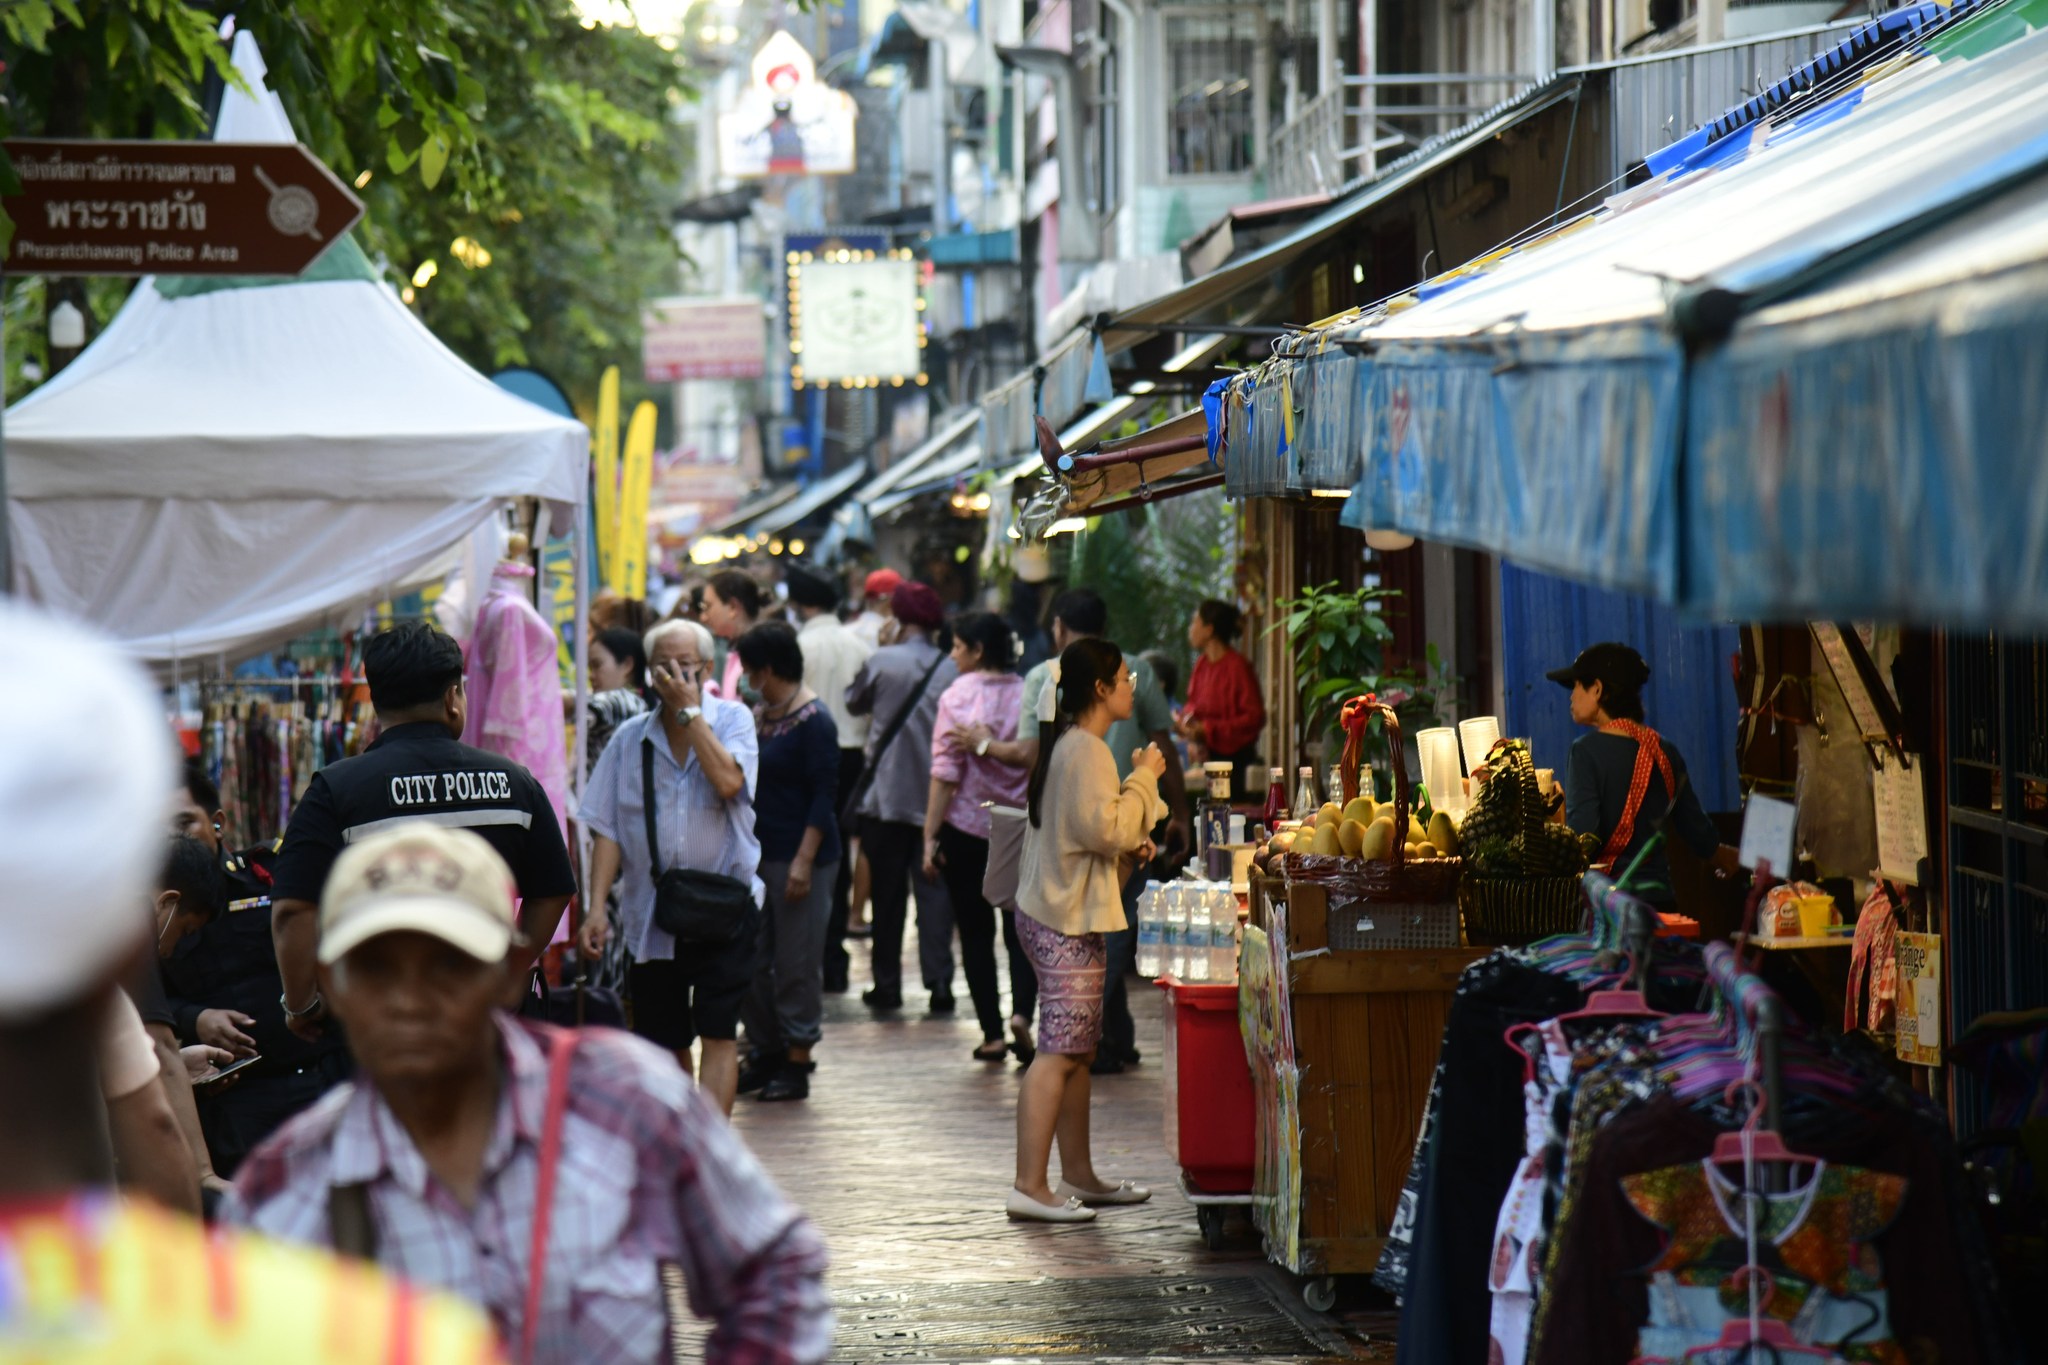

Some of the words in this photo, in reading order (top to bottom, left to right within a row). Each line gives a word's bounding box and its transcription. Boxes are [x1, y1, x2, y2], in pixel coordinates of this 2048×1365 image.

[45, 189, 207, 231] พระราชวัง
[147, 242, 194, 261] Police
[201, 243, 239, 262] Area
[391, 775, 437, 805] CITY
[442, 772, 511, 801] POLICE
